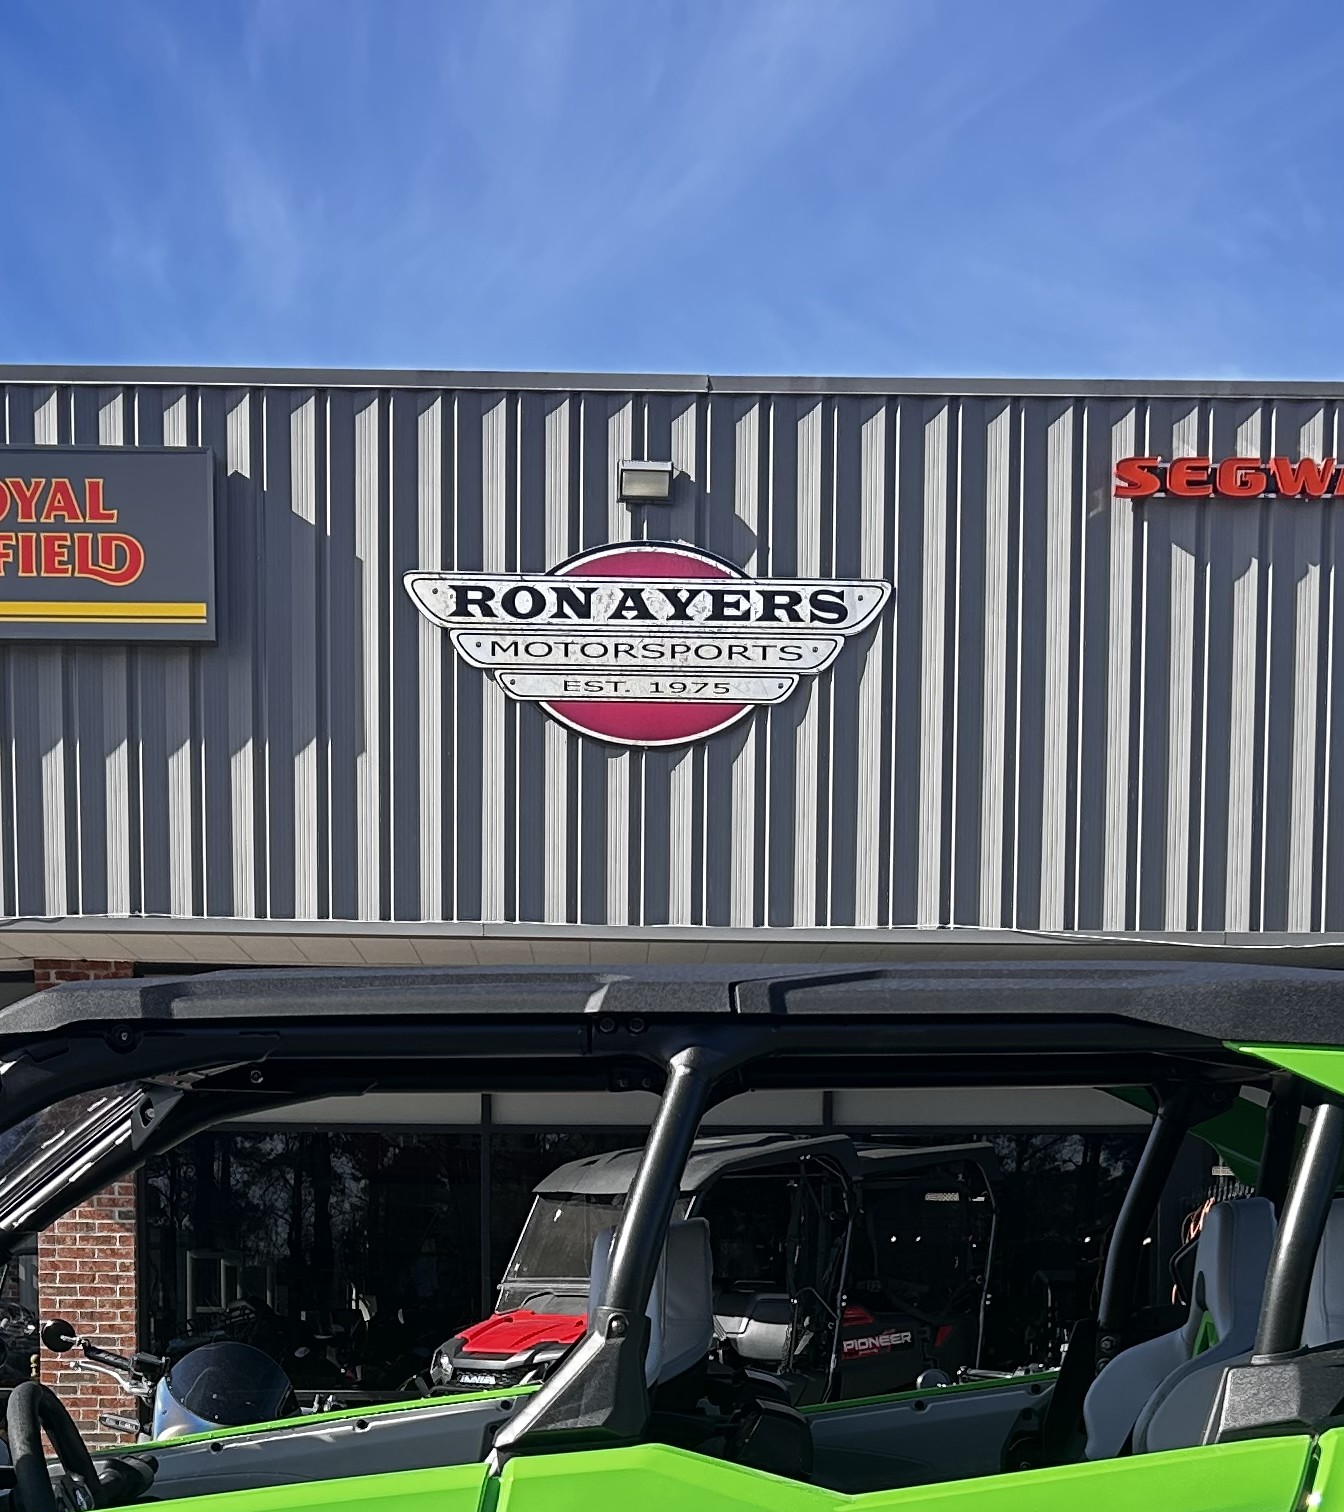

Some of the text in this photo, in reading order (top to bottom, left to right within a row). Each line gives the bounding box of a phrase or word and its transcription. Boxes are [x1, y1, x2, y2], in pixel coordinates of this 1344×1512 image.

[449, 584, 849, 624] RON AYERS
[490, 641, 804, 662] MOTORSPORTS
[562, 679, 732, 695] EST. 1975
[843, 1331, 912, 1353] PIONEER
